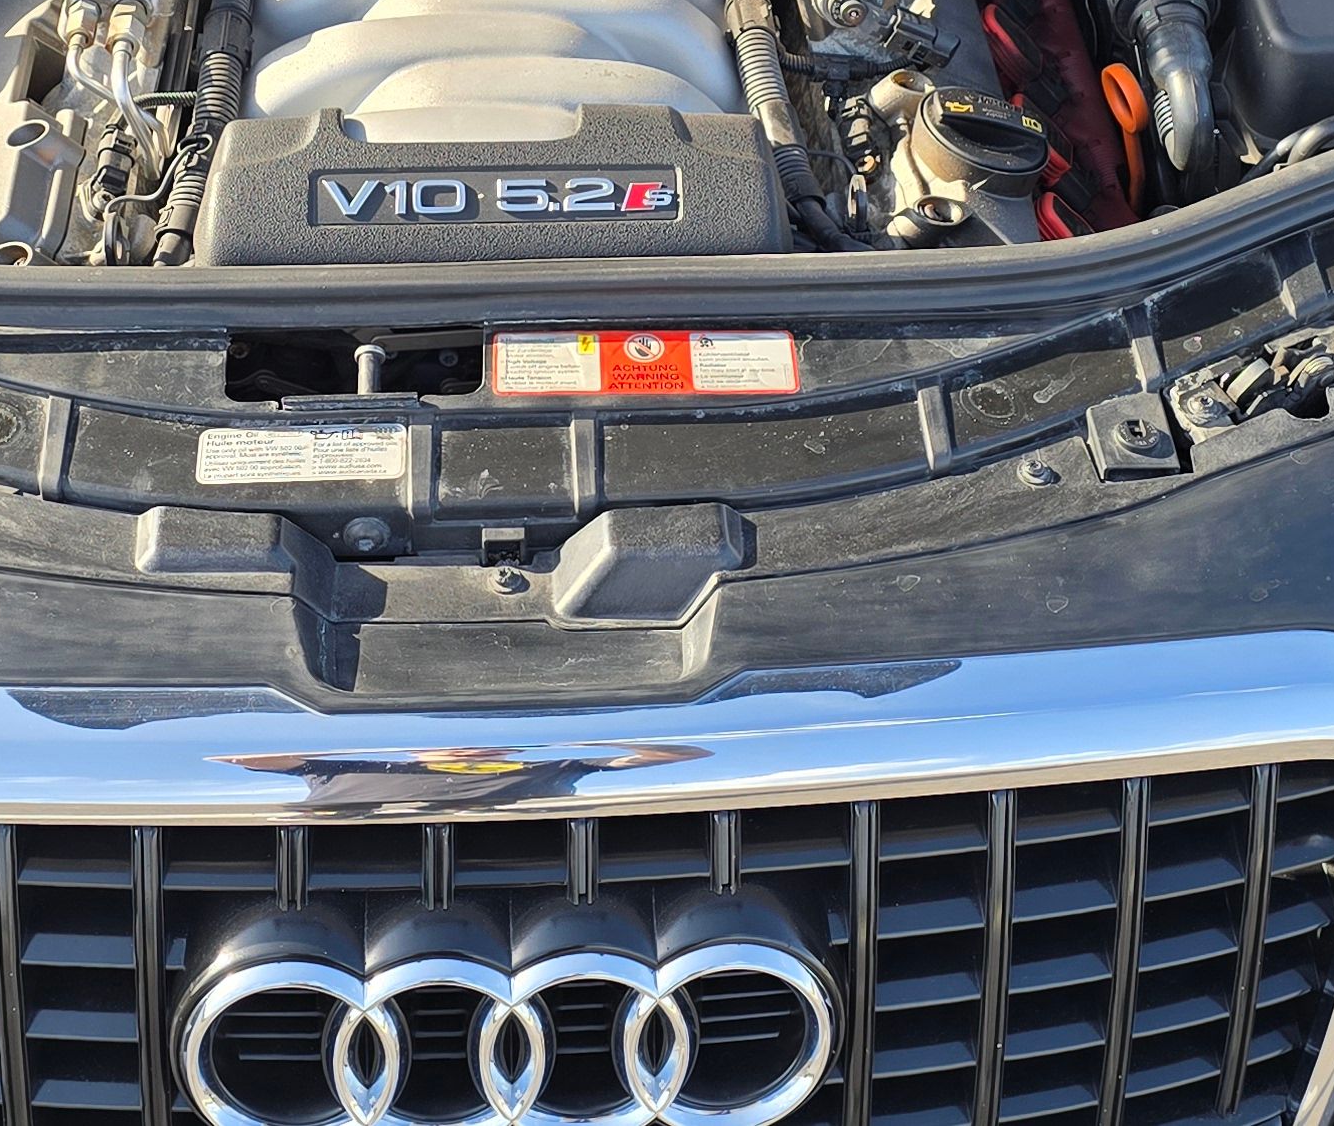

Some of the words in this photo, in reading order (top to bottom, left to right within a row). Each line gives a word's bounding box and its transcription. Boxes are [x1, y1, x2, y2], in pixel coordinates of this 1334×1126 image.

[322, 178, 466, 216] V10
[496, 177, 615, 212] 5.2
[612, 364, 678, 372] ACHTUNG
[612, 373, 680, 381] WARNING
[608, 381, 684, 390] ATTENTION
[208, 433, 242, 441] Engine
